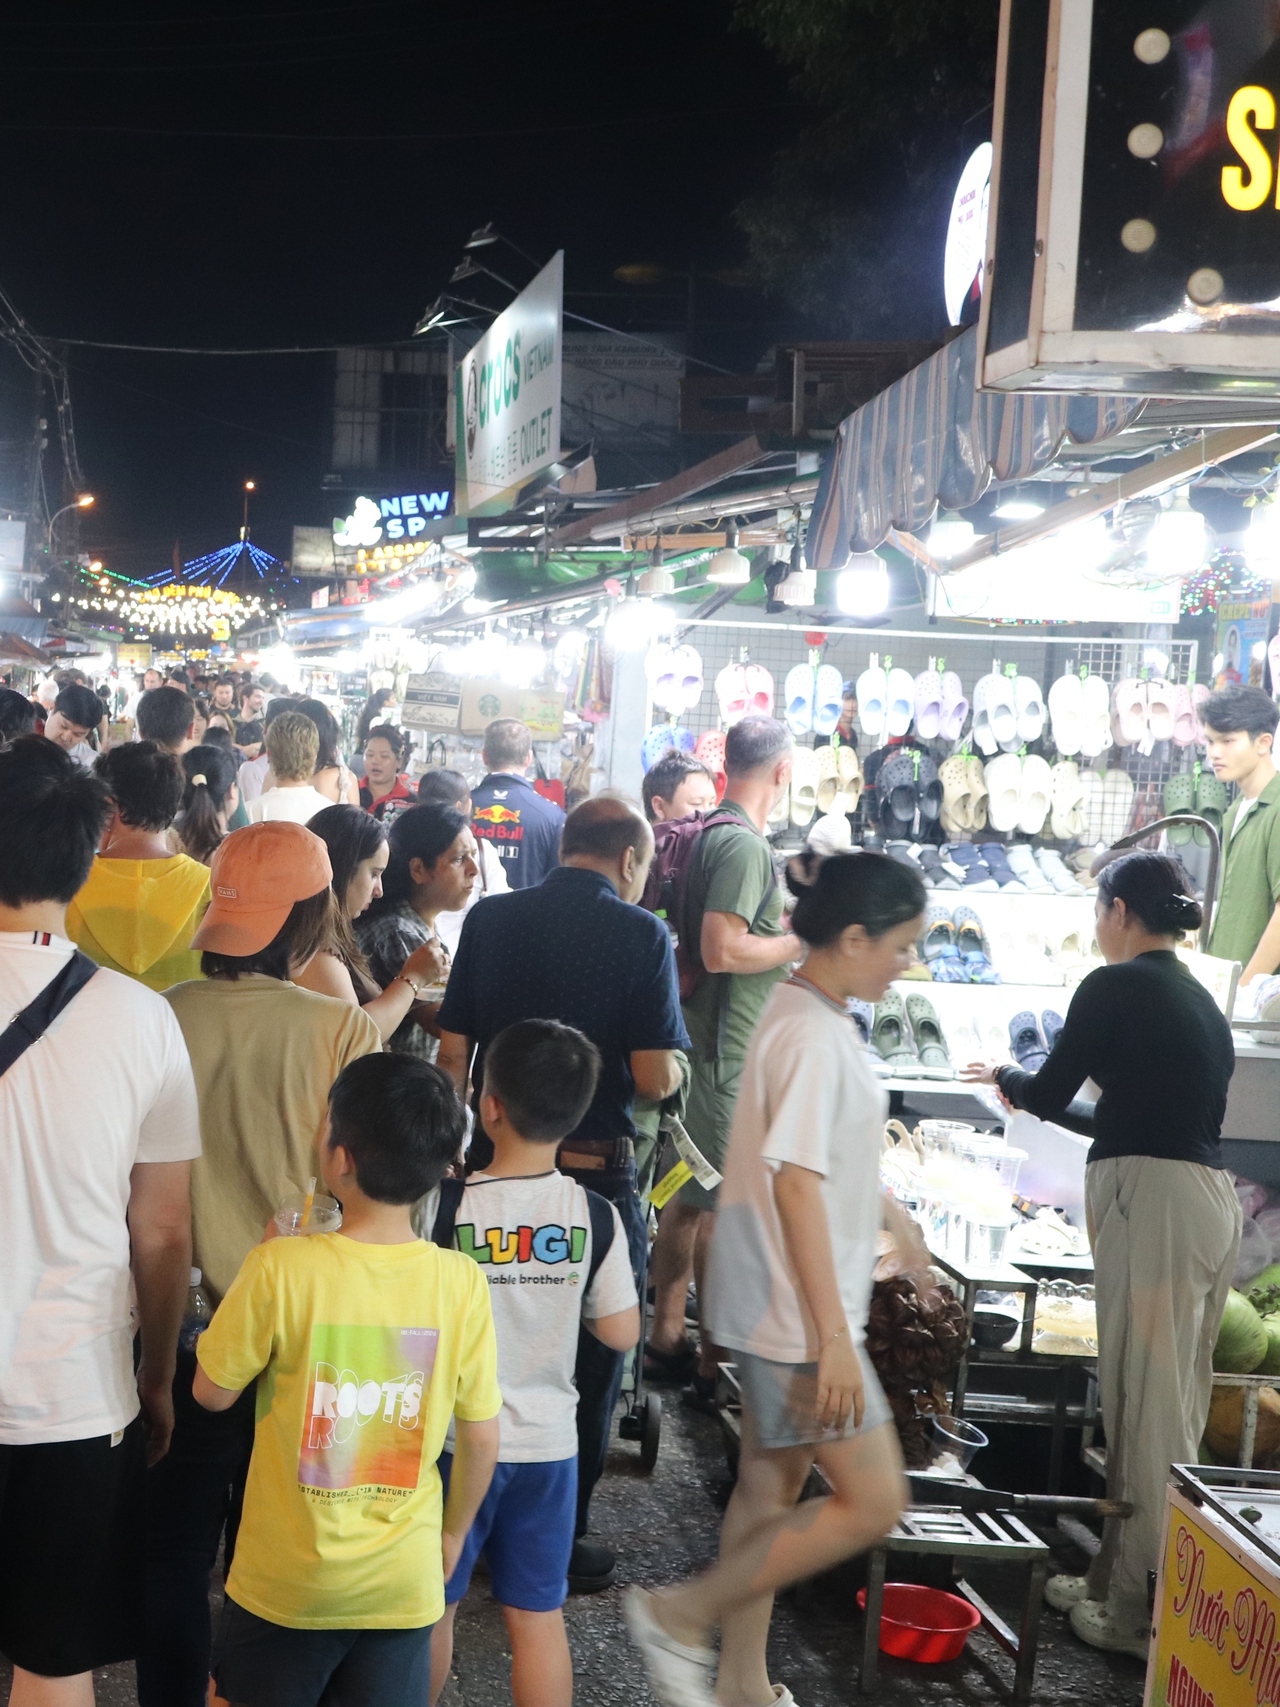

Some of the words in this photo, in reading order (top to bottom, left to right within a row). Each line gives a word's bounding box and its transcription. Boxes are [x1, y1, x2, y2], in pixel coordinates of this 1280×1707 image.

[479, 329, 520, 429] crocs
[520, 407, 552, 467] OUTLET
[380, 490, 450, 518] NEW
[386, 515, 443, 539] SP
[471, 823, 496, 838] Red
[497, 825, 524, 840] Bull
[455, 1223, 587, 1265] LUIGI
[486, 1274, 516, 1285] liable
[519, 1274, 565, 1285] brother
